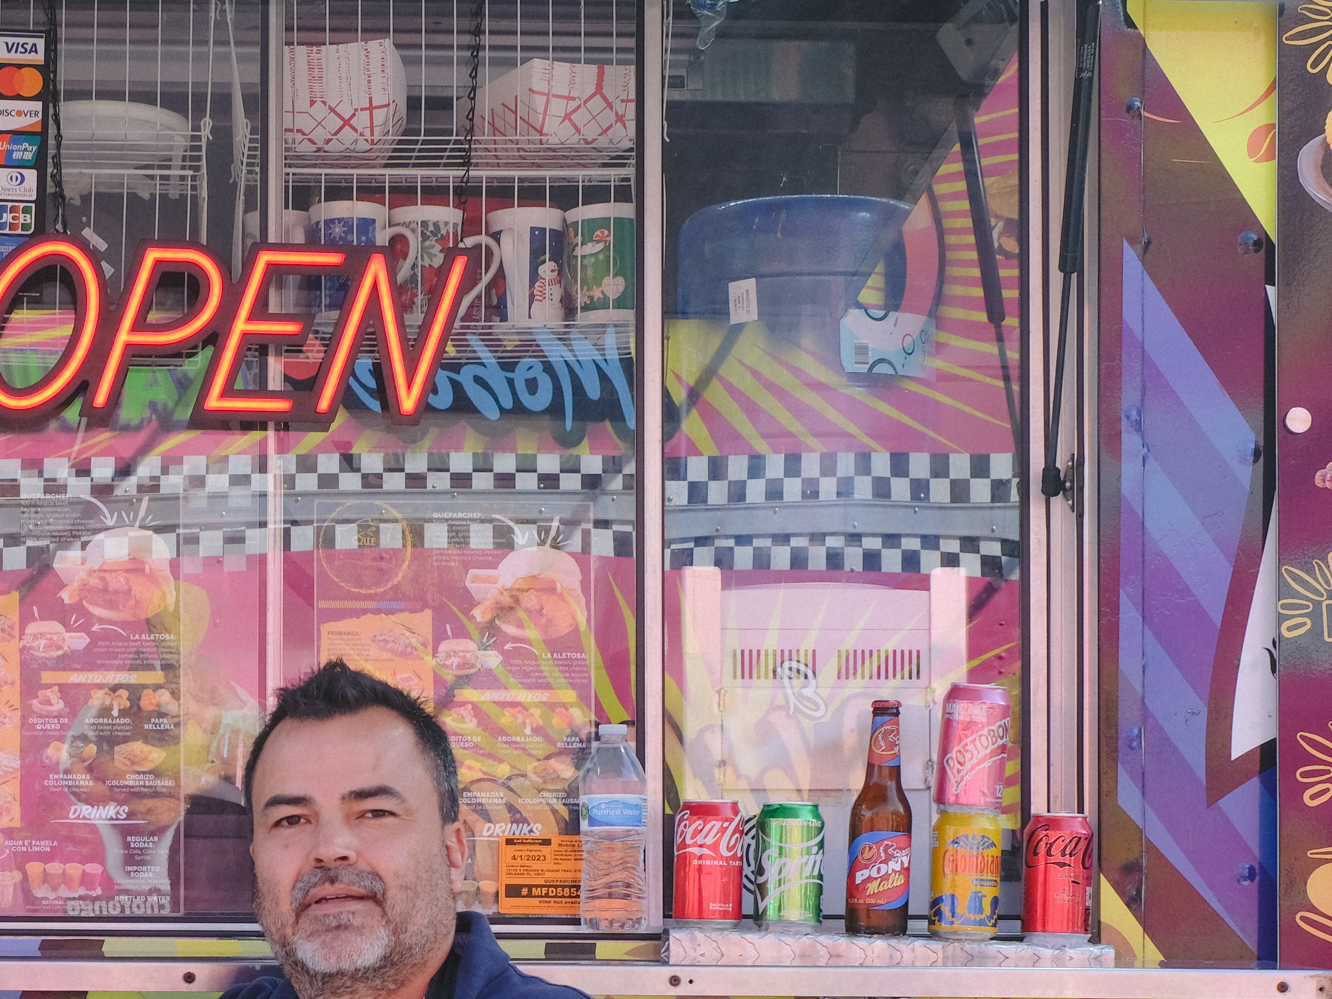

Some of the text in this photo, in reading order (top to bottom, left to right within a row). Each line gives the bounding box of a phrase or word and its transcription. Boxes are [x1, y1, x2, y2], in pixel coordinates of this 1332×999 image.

[3, 41, 39, 55] VISA
[0, 142, 37, 153] UnionPay
[18, 186, 34, 194] Club
[68, 673, 138, 683] ANTOJITOS
[68, 805, 129, 819] DRINKS
[482, 823, 542, 836] DRINKS
[755, 845, 824, 887] Sprit
[855, 853, 911, 885] PONY
[865, 873, 906, 895] Malta
